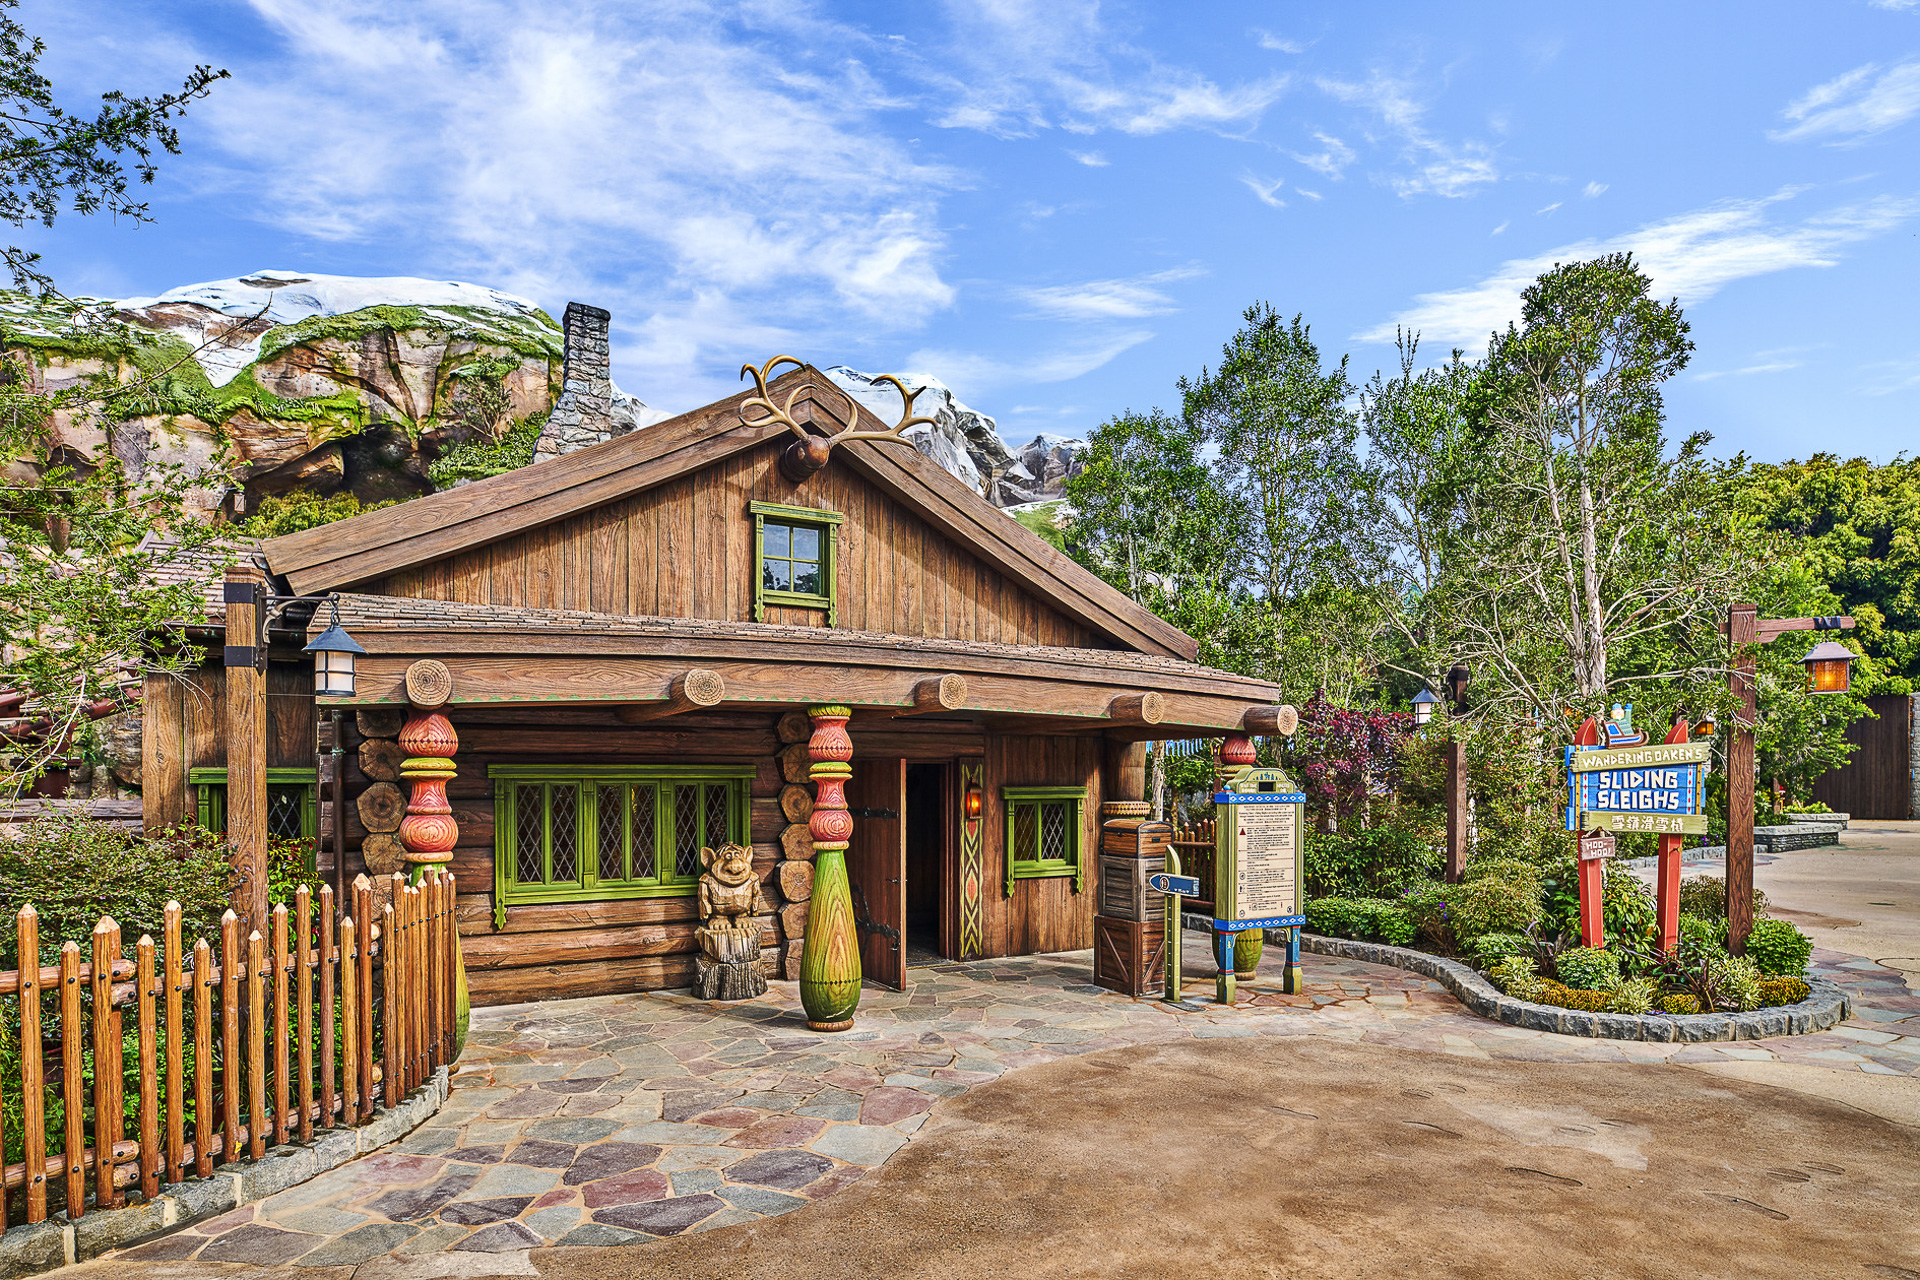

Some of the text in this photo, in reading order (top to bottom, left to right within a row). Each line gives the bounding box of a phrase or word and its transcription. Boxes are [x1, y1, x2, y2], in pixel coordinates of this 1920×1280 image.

[1582, 747, 1702, 768] WANDERING OAKEN'S
[1599, 769, 1678, 789] SLIDING
[1597, 790, 1679, 810] SLEIGHS
[1586, 841, 1607, 851] HOO-
[1590, 847, 1611, 857] HOO!
